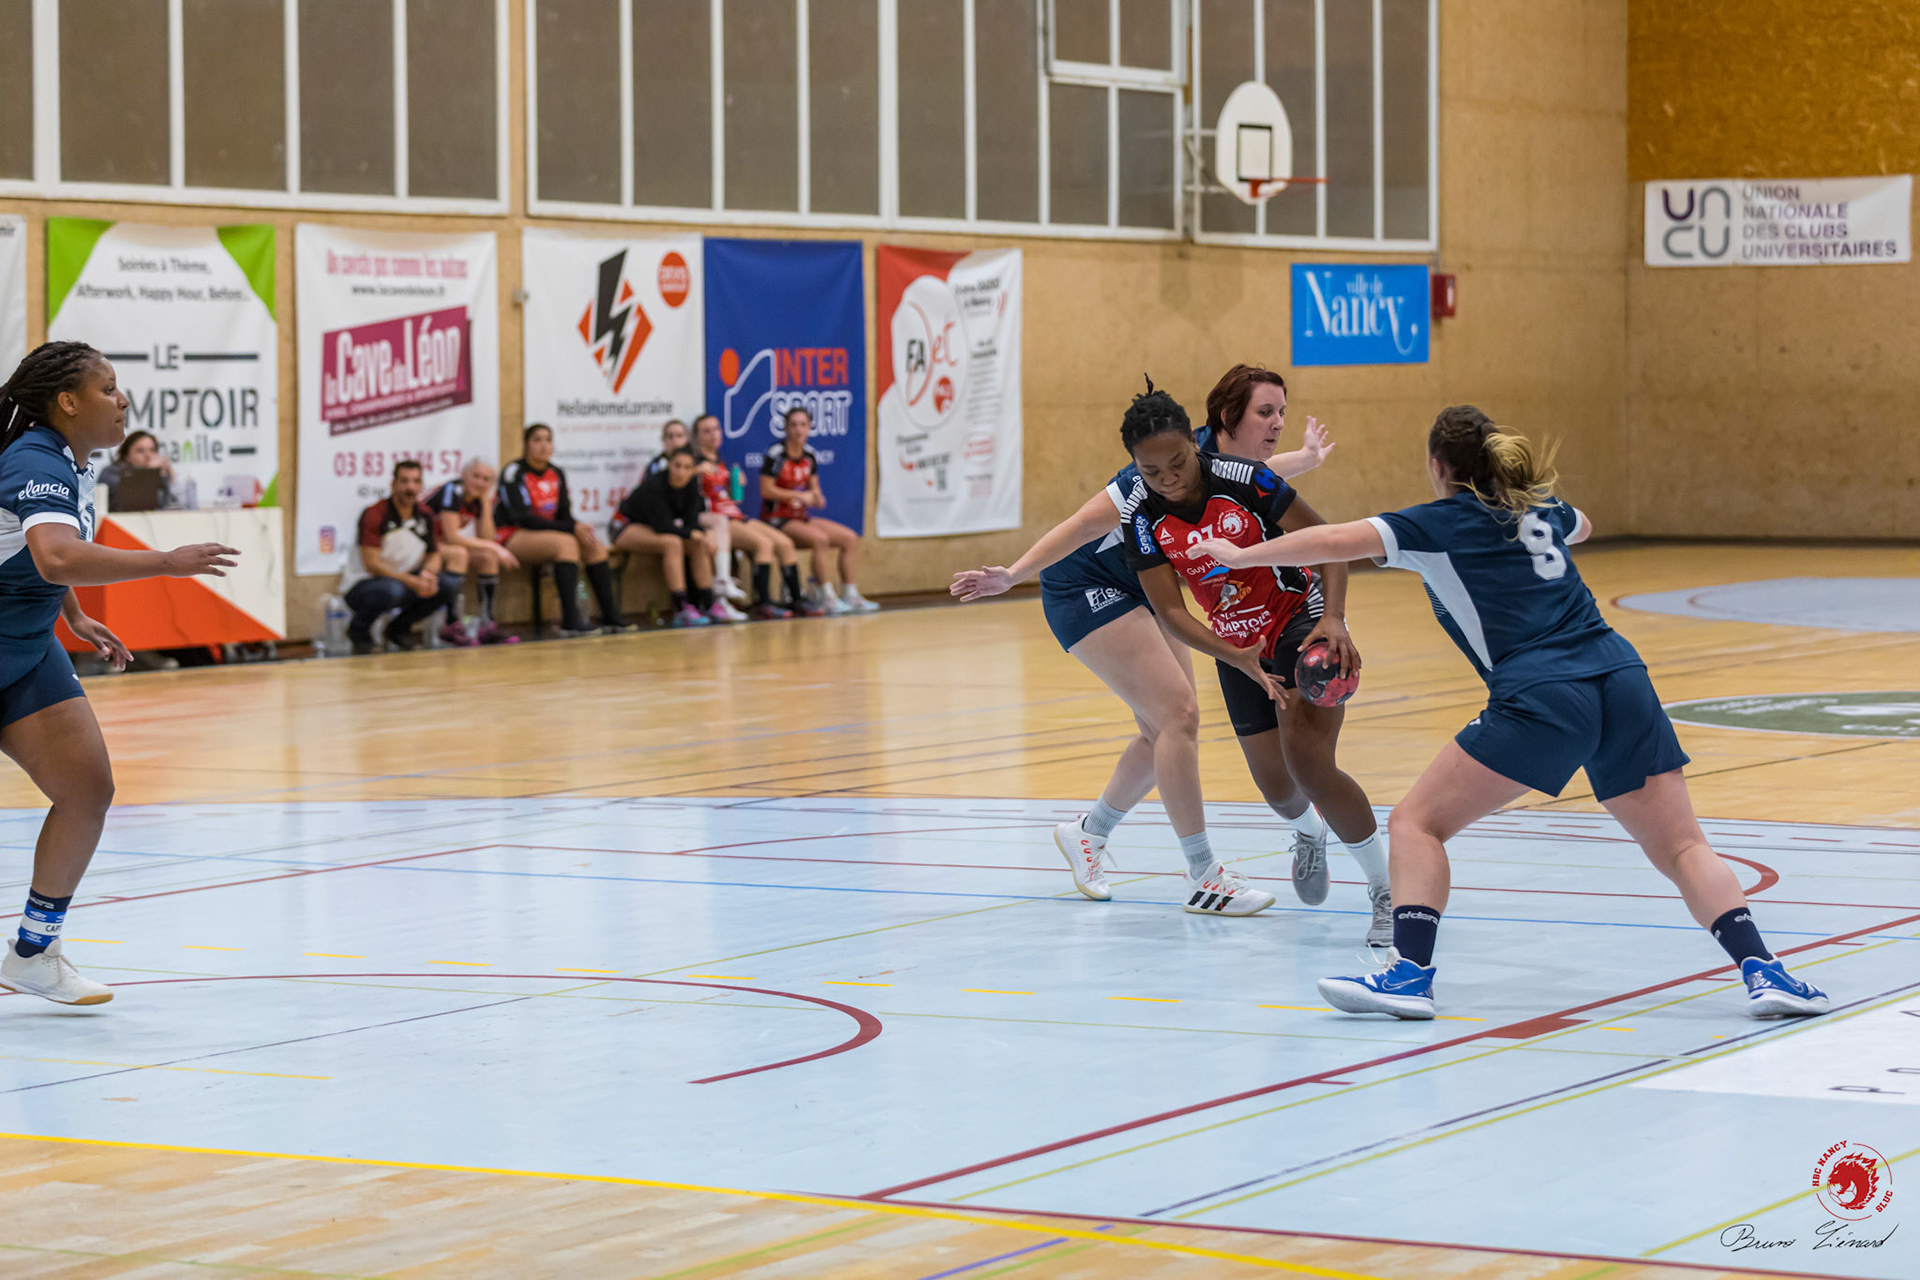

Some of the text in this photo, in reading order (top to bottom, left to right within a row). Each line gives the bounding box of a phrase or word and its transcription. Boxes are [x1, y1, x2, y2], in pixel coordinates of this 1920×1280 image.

[1742, 185, 1800, 202] UNION
[1742, 202, 1849, 220] NATIONALE
[1742, 223, 1848, 240] DES CLUBS
[1742, 240, 1898, 259] UNIVERSITAIRES
[1346, 272, 1383, 294] ville de
[1303, 271, 1418, 356] Nancy
[153, 344, 180, 370] LE
[336, 330, 393, 403] Cave
[404, 315, 461, 388] Léon
[775, 347, 849, 386] INTER
[125, 388, 258, 428] MPTOIR
[557, 398, 673, 417] HelloHomeLorraine
[334, 451, 358, 477] 03
[363, 450, 385, 477] 83
[18, 479, 70, 500] elancia
[1519, 511, 1567, 580] 8
[1187, 563, 1206, 576] Guy
